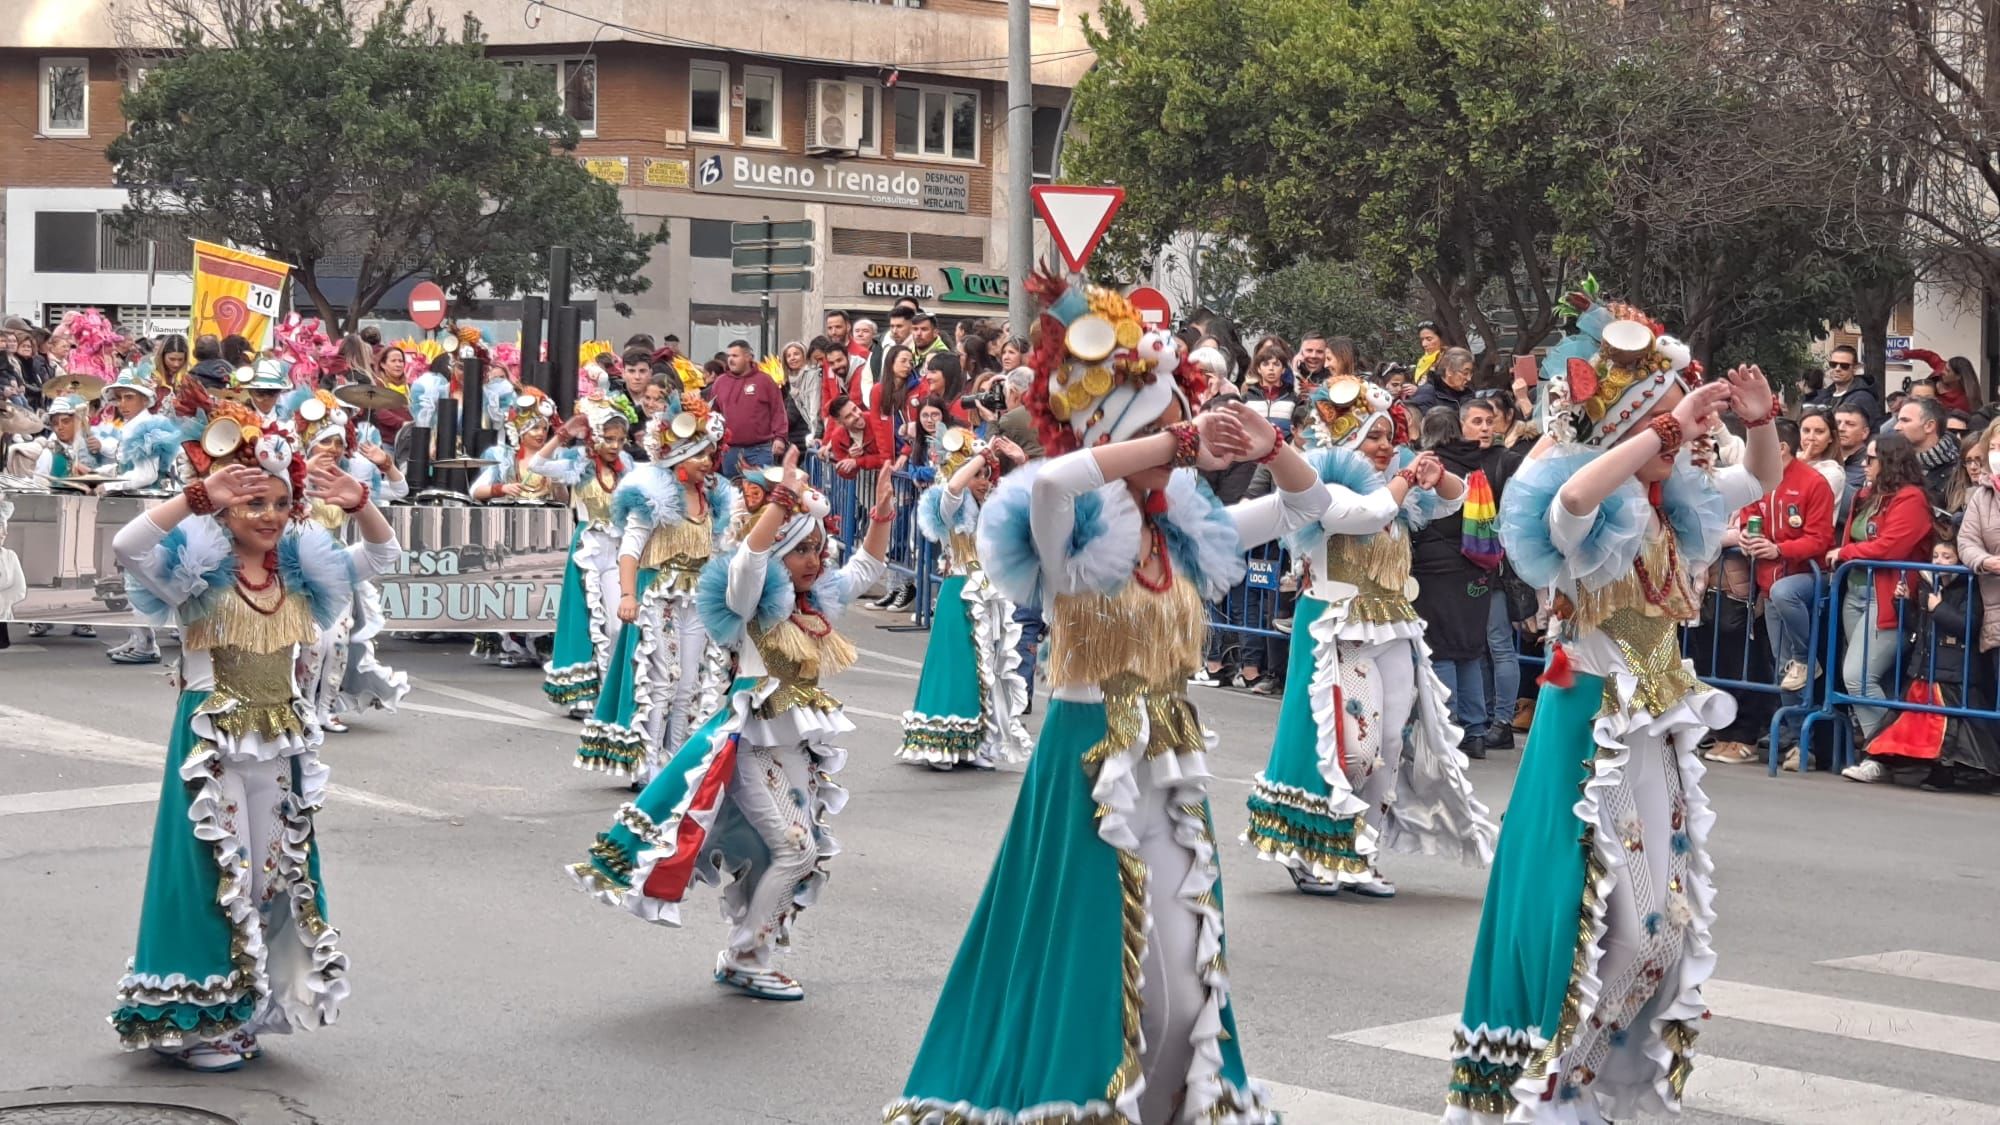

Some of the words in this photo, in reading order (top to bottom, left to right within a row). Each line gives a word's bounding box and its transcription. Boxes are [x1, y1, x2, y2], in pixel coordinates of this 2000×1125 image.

[733, 156, 815, 187] Bueno
[823, 164, 920, 196] Trenado
[925, 172, 964, 185] DESPACHO
[924, 184, 965, 198] TRIBUTARIO
[871, 194, 919, 206] consultores
[923, 198, 964, 210] MERCANTIL
[866, 264, 920, 279] JOYERIA
[864, 282, 934, 298] RELOJERIA
[255, 291, 273, 309] 10
[1250, 573, 1269, 584] LOCAL
